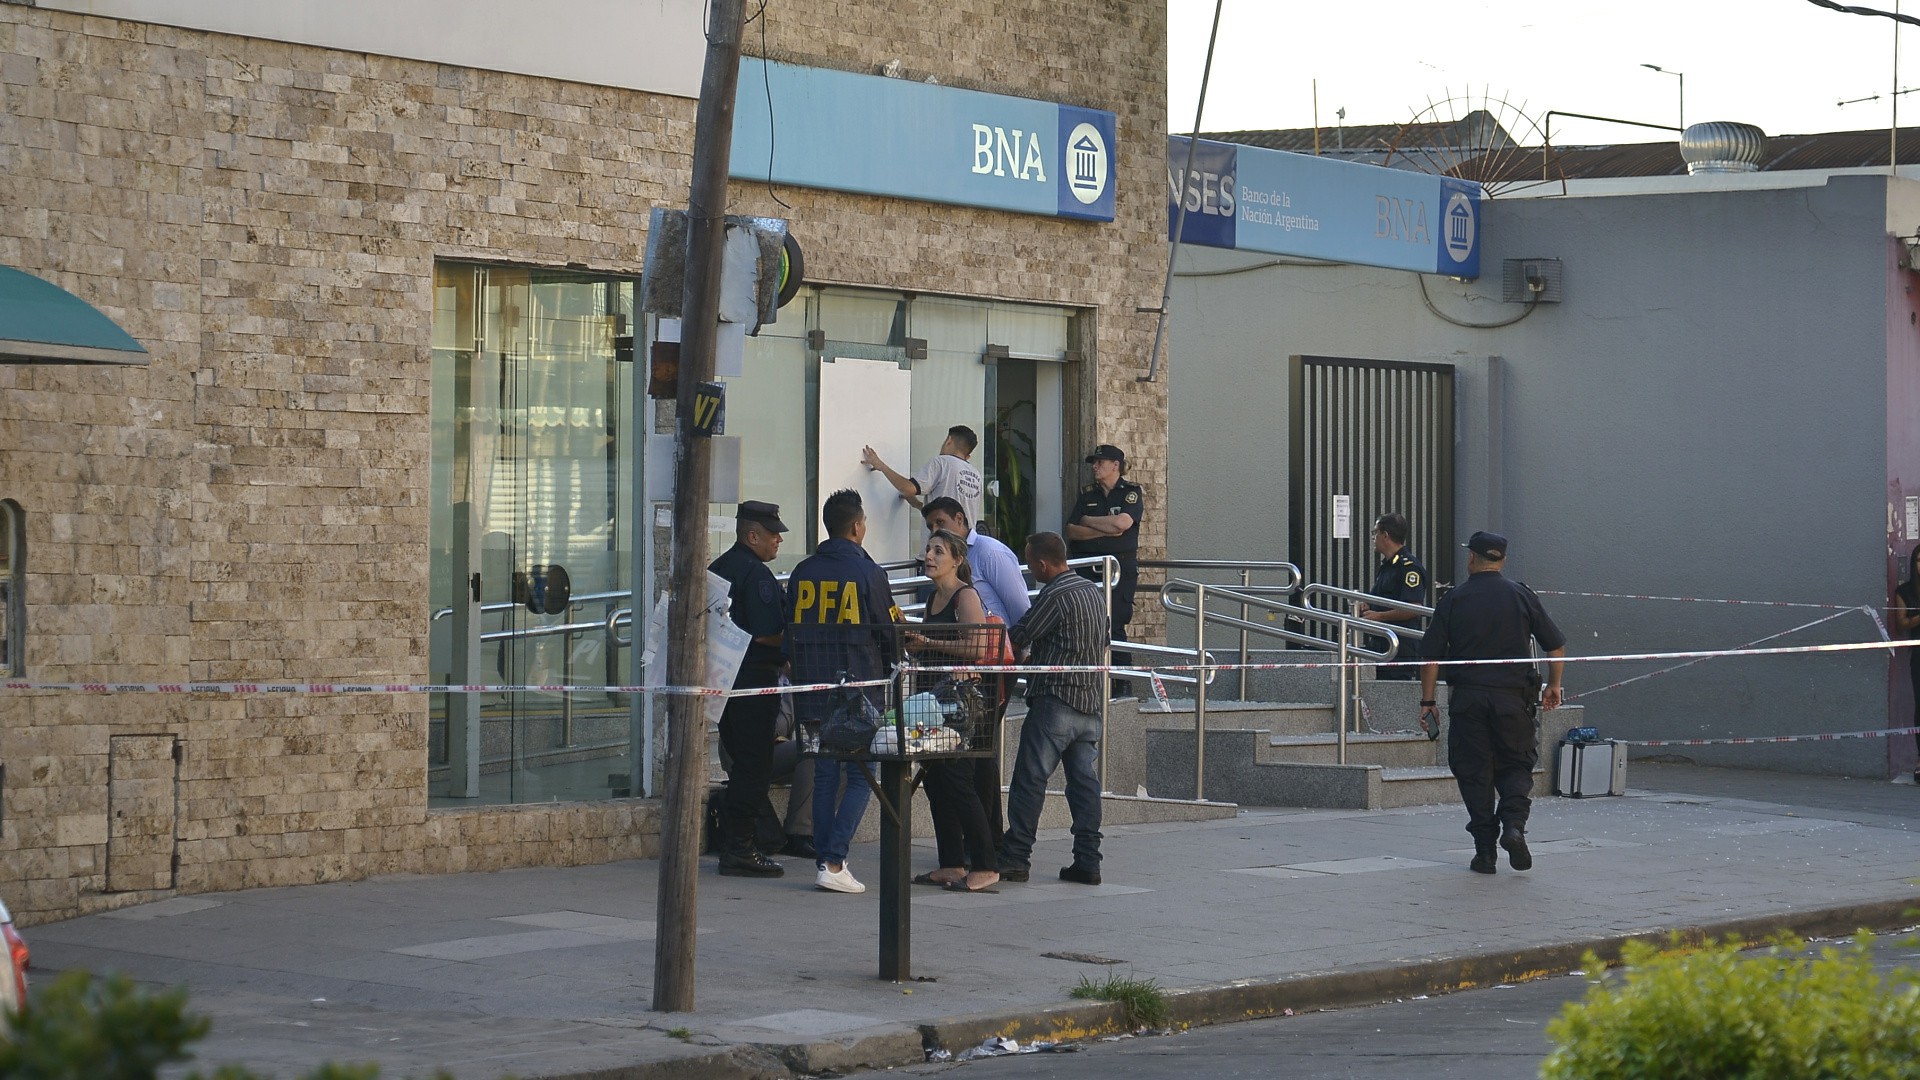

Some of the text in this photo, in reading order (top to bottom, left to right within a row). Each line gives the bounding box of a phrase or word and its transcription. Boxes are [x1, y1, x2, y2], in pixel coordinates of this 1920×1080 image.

[972, 123, 1047, 182] BNA
[1241, 205, 1319, 231] Nación Argentina
[1242, 186, 1291, 208] Banco de la
[1375, 194, 1431, 245] BNA
[794, 580, 860, 624] PFA
